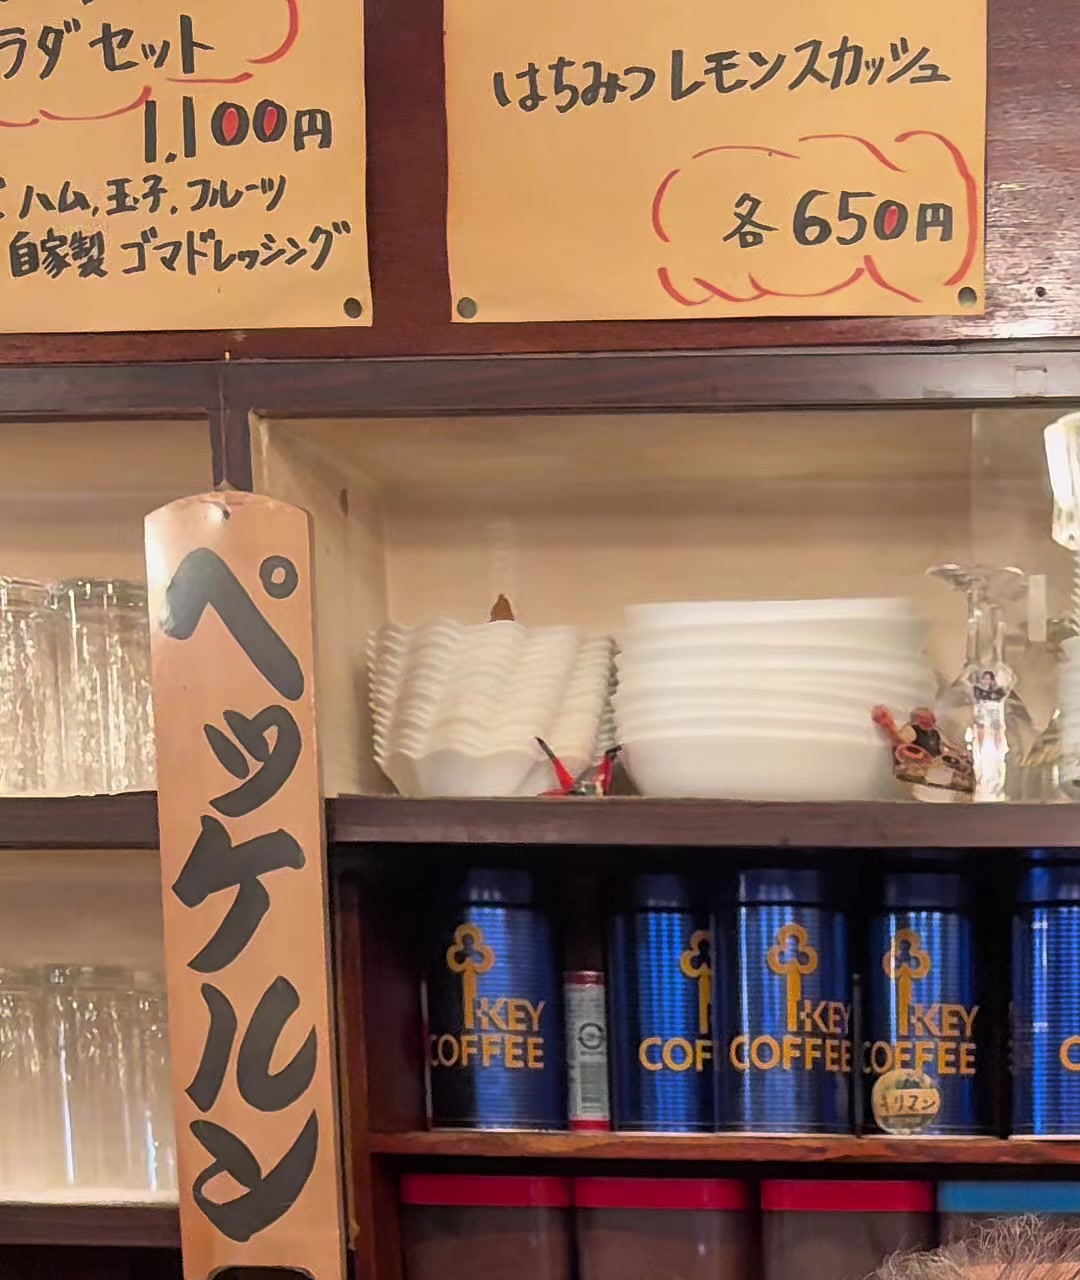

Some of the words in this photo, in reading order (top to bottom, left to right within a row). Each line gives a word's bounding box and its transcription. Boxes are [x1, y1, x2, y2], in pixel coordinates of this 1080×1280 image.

[158, 546, 318, 1243] ペッケルン
[476, 997, 546, 1031] KEY
[910, 1003, 980, 1037] KEY
